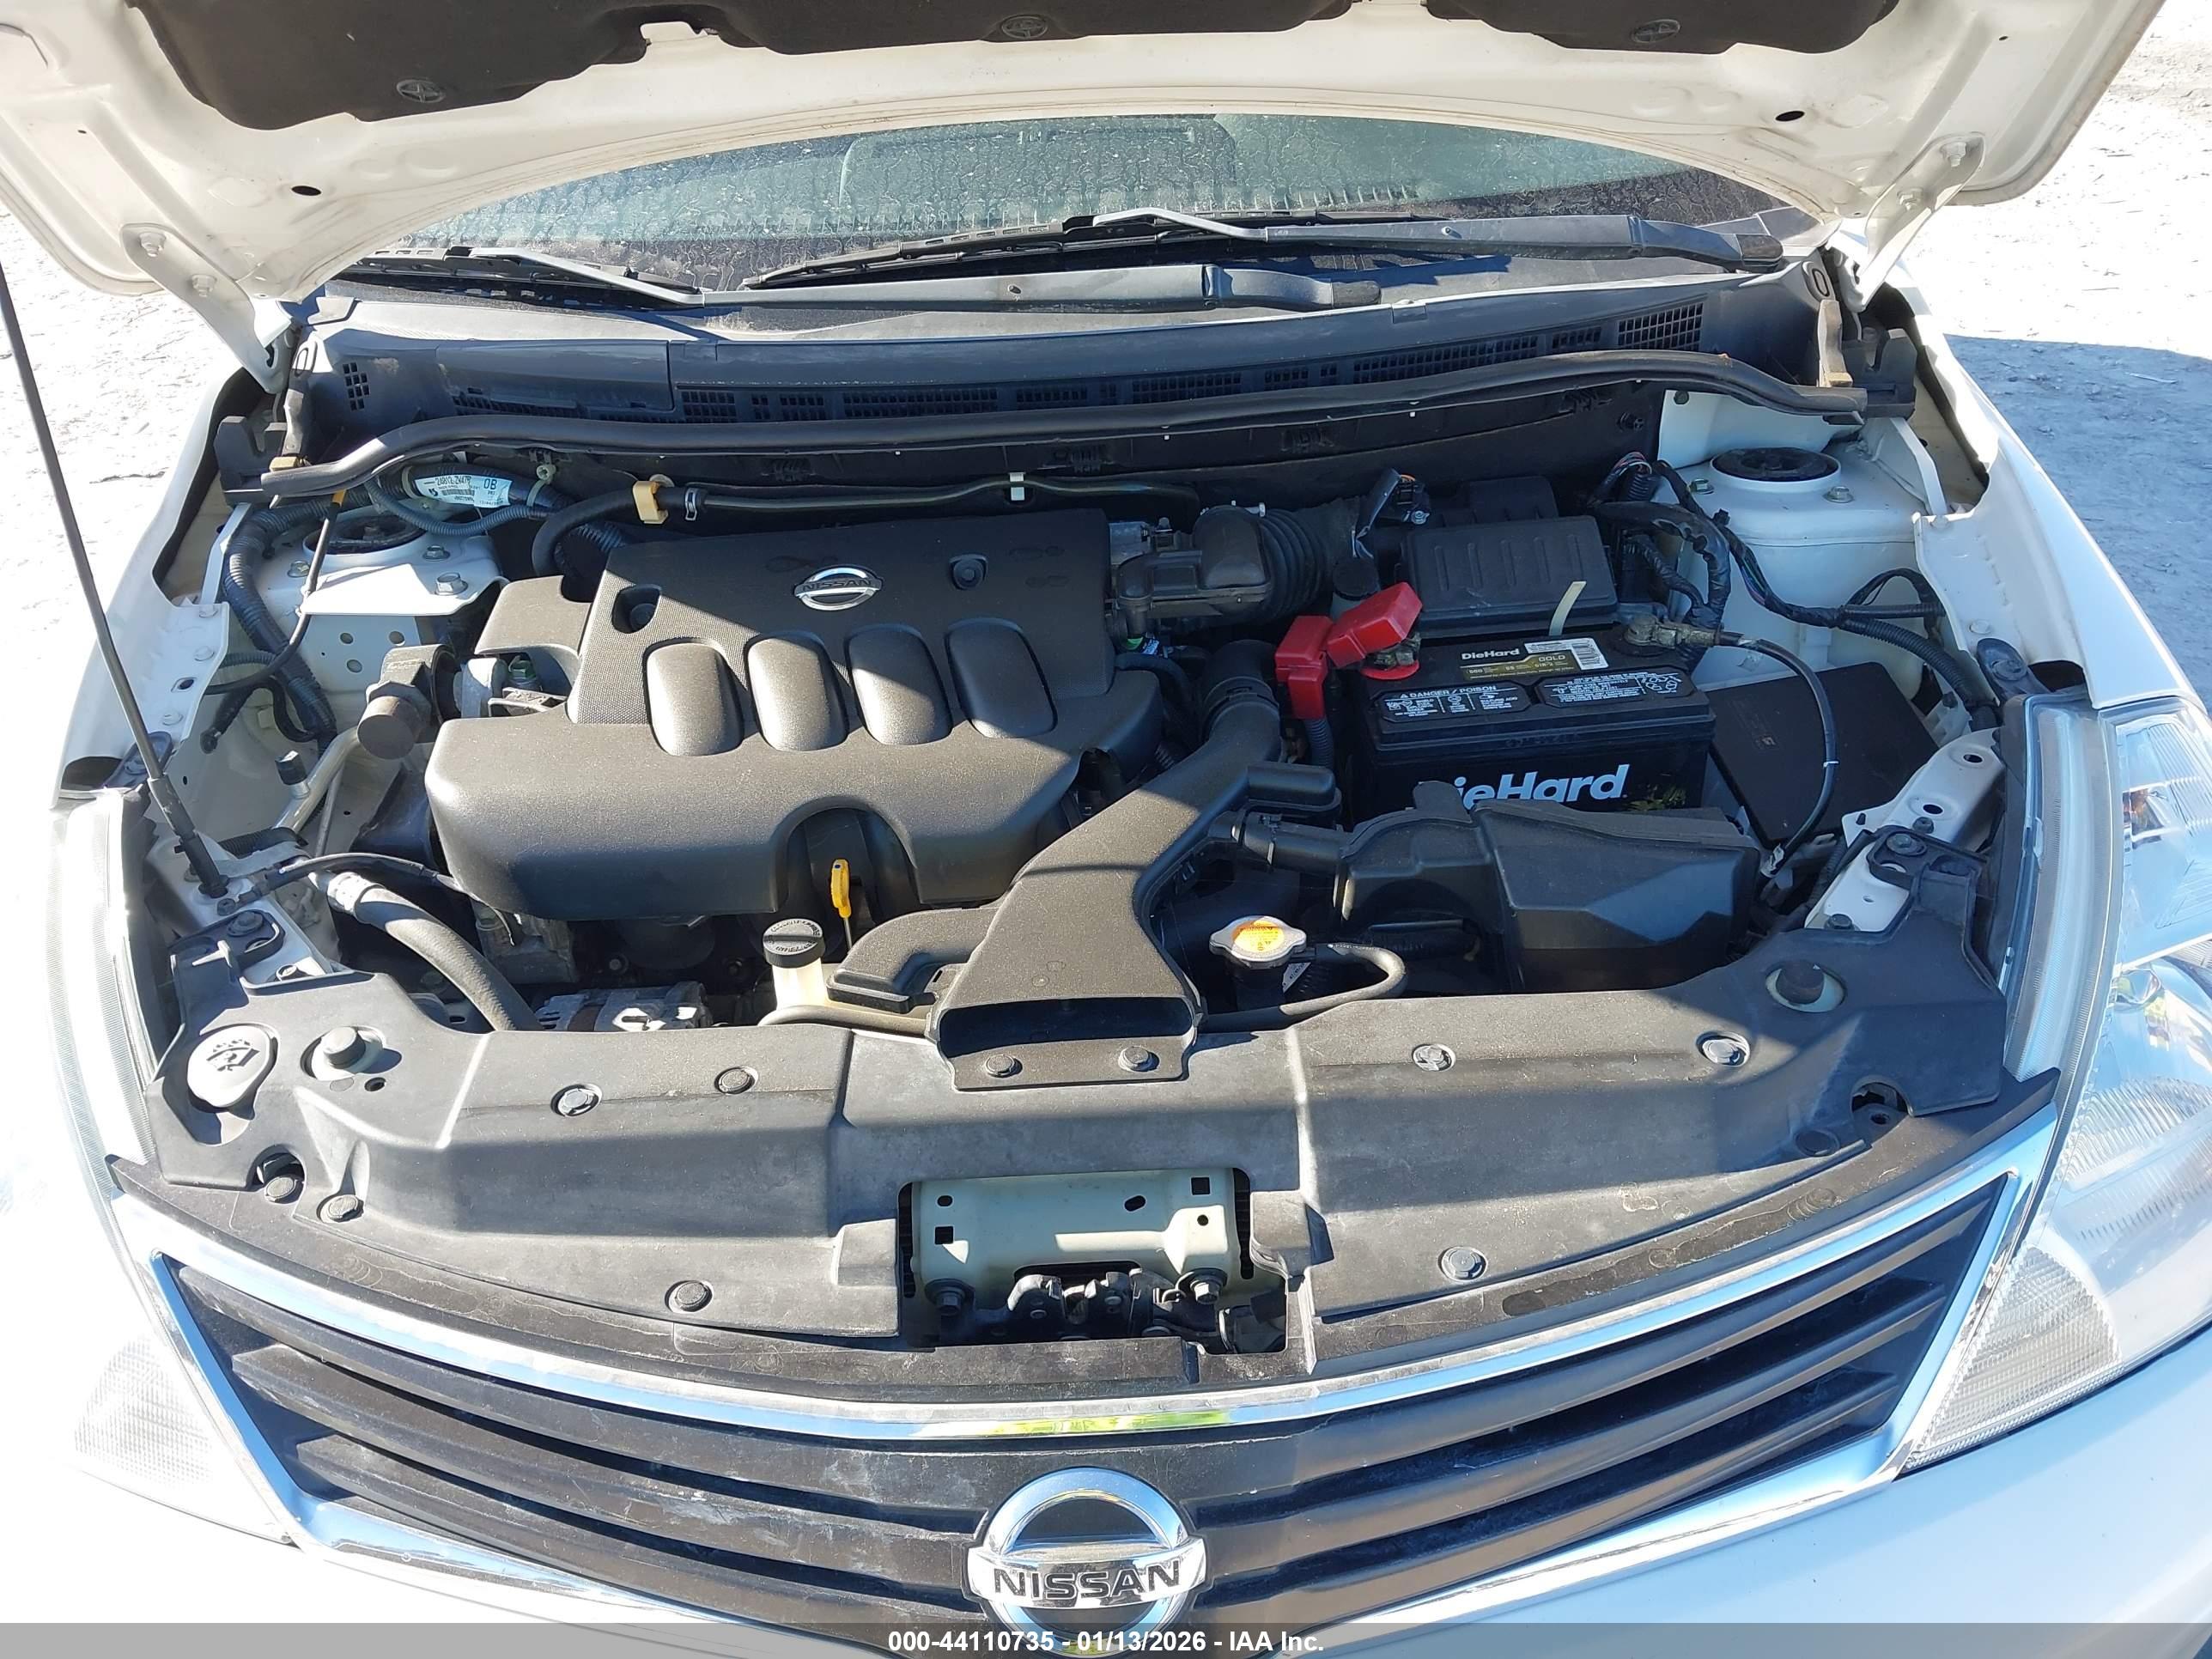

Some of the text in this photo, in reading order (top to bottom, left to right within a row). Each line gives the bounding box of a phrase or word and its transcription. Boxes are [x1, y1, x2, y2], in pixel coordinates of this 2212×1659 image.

[802, 578, 872, 592] NISSAN
[1462, 648, 1520, 660] DieHard
[1409, 690, 1450, 698] DANGER
[1454, 763, 1630, 811] ieHard
[993, 1558, 1181, 1599] NISSAN
